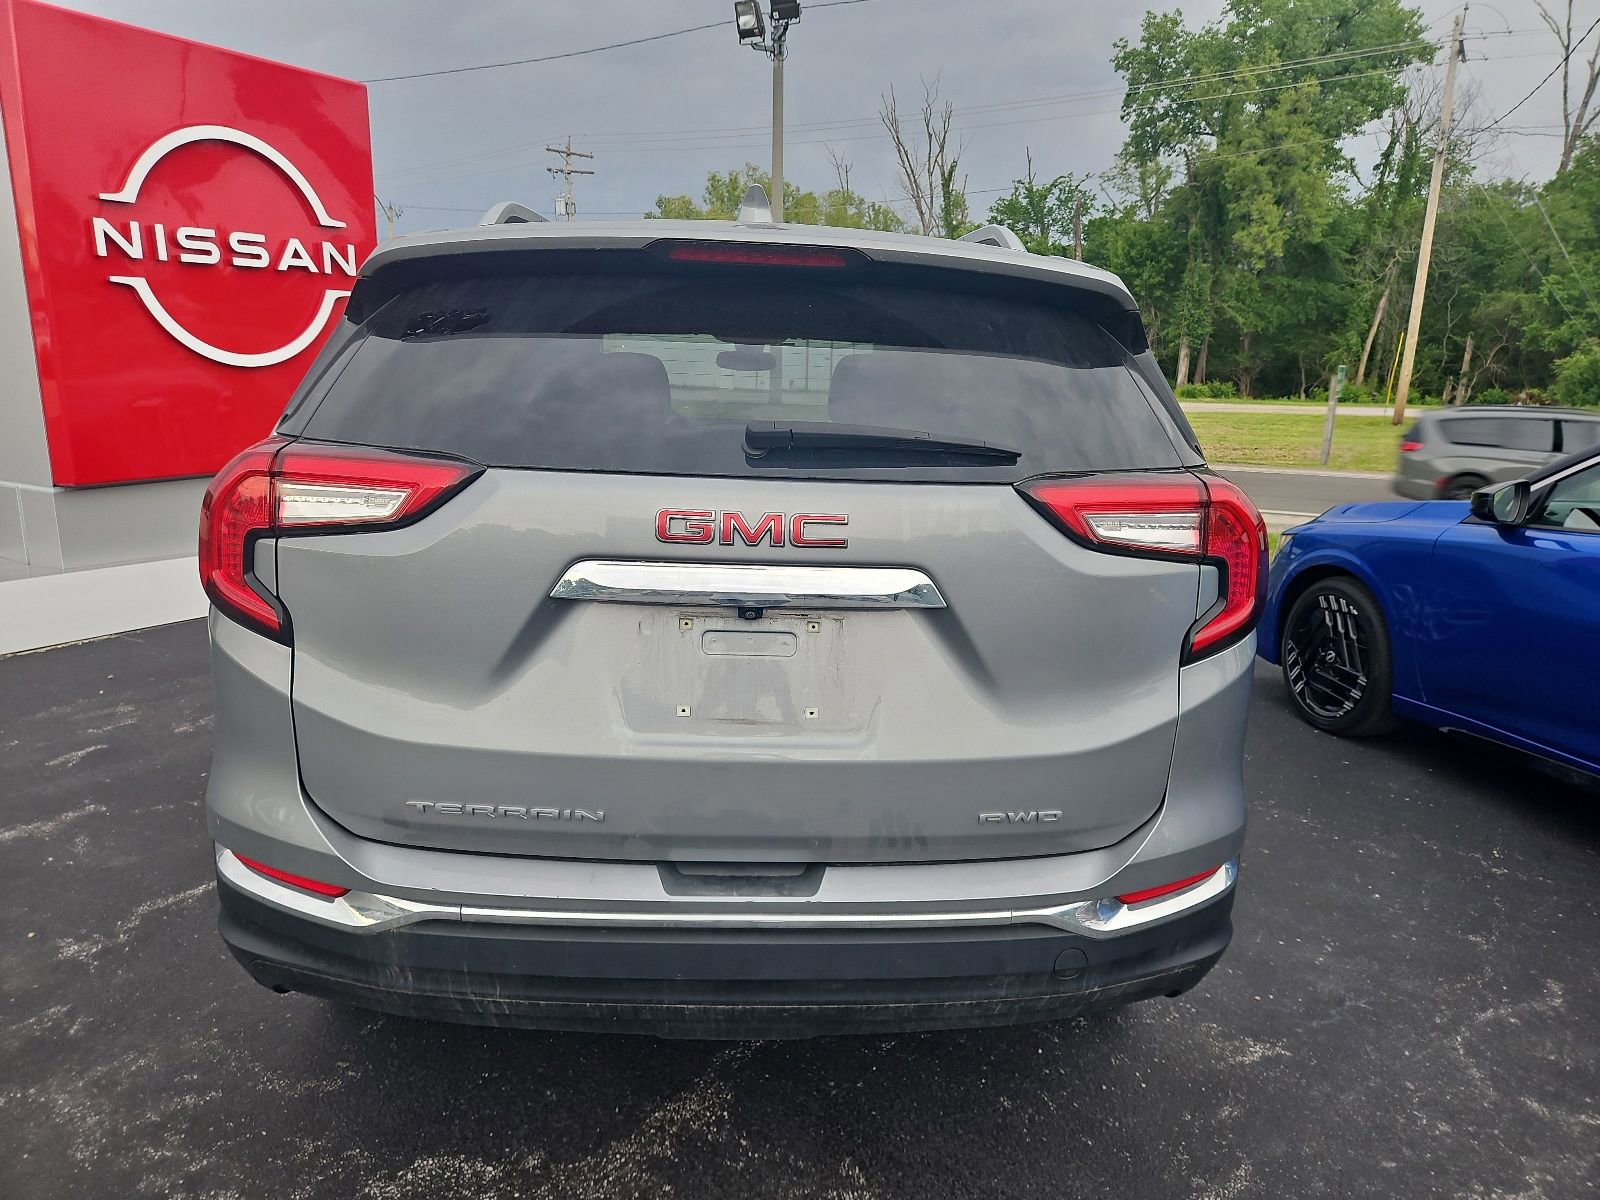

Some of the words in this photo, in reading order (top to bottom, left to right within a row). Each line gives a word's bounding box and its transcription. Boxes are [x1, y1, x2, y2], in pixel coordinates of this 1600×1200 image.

[92, 216, 357, 277] NISSAN
[655, 507, 849, 549] GMC
[405, 801, 605, 823] TERRAIN
[978, 810, 1063, 824] AWD
